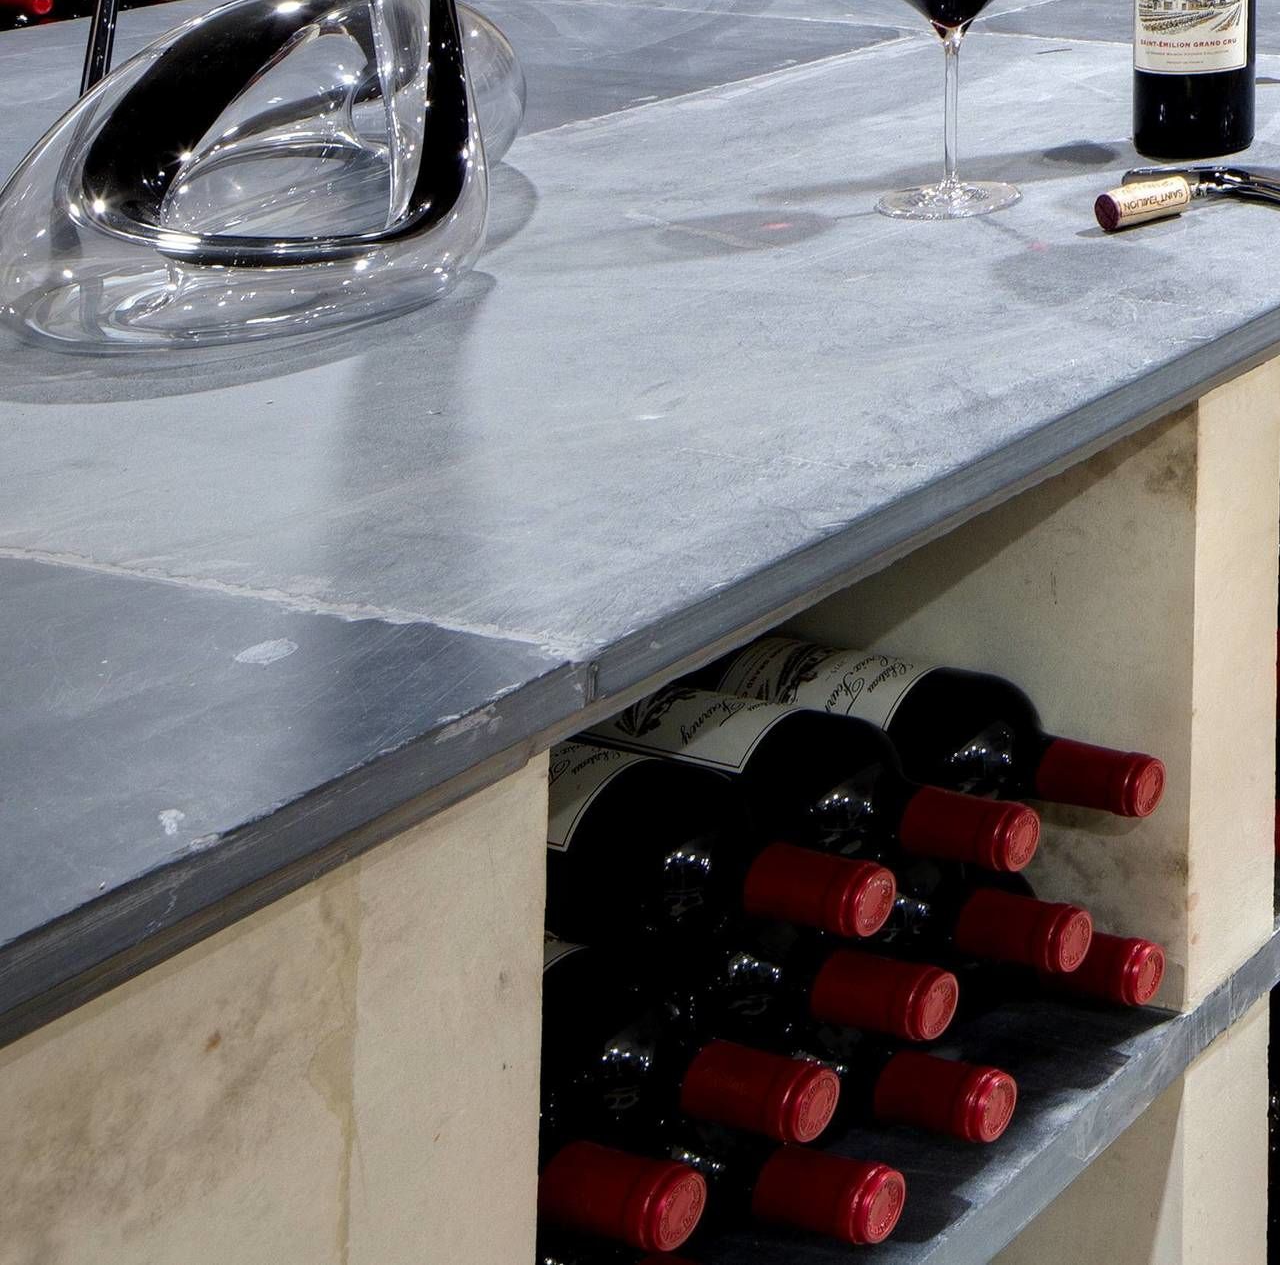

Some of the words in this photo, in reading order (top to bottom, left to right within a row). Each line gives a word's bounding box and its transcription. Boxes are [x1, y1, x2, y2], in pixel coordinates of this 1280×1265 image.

[1140, 38, 1191, 48] SAINT-ÉMILION
[1193, 40, 1221, 48] GRAND
[1223, 38, 1237, 46] CRU
[1162, 188, 1184, 203] SAINT
[824, 671, 865, 716] Four
